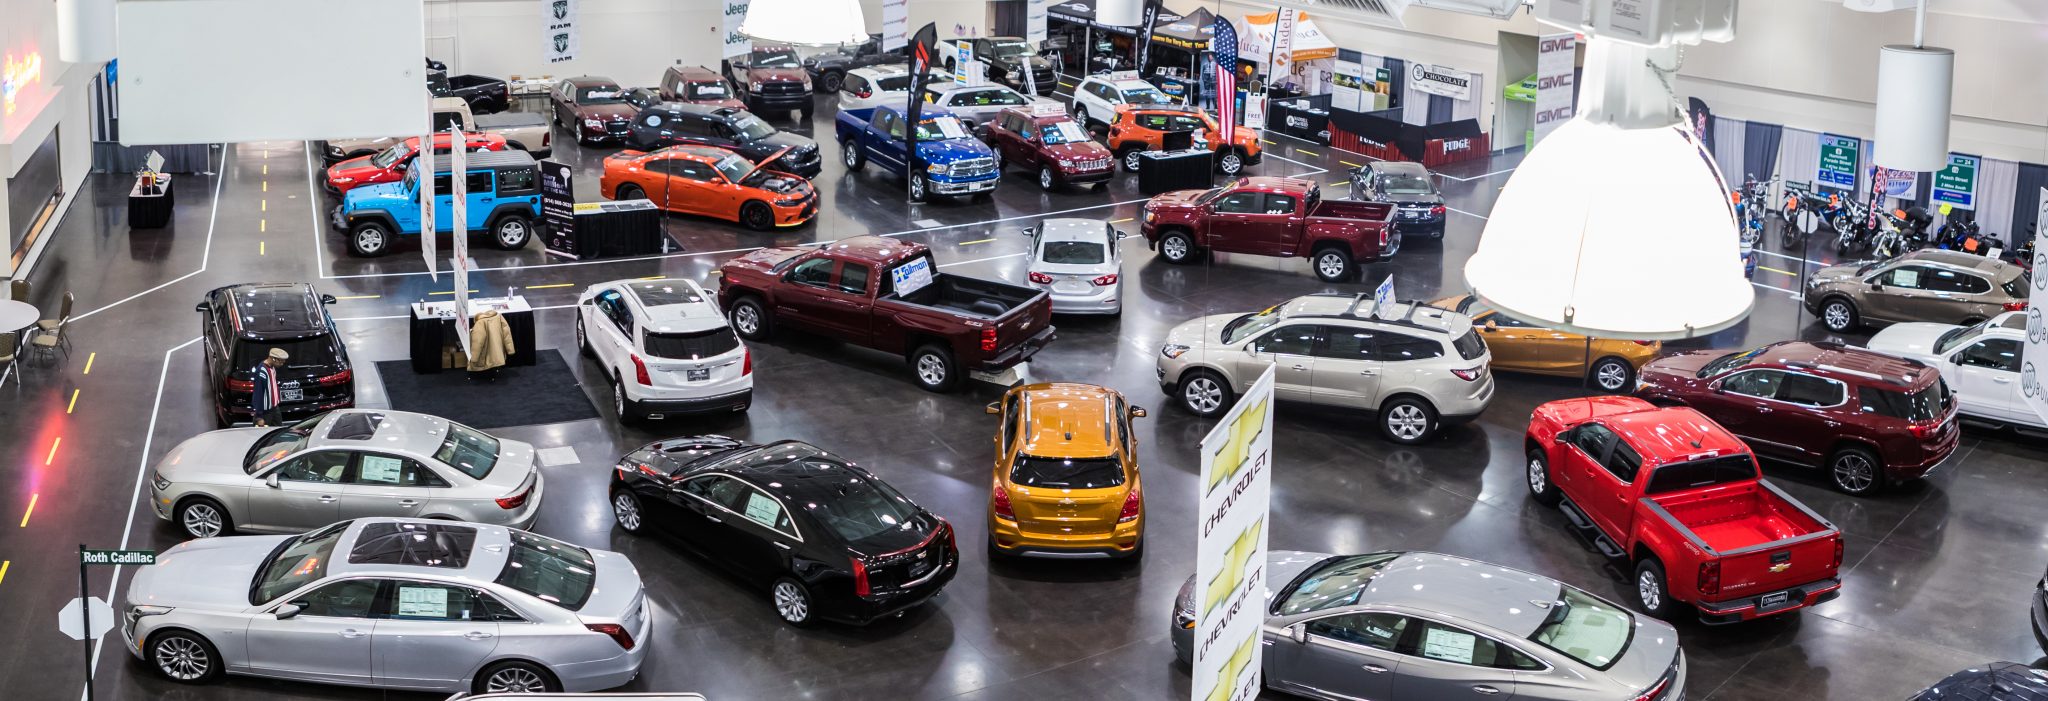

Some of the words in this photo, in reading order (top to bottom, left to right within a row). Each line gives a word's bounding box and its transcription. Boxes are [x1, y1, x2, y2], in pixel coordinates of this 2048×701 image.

[725, 2, 748, 16] Jeep
[1540, 38, 1575, 53] GMC
[1425, 73, 1465, 87] CHOCOLATE
[1538, 74, 1572, 90] GMC
[1536, 107, 1570, 124] GMC
[1443, 138, 1469, 153] FUDGE
[2036, 382, 2048, 406] BUI
[1204, 449, 1267, 539] CHEVROLET
[83, 551, 108, 563] Roth
[110, 551, 153, 563] Cadillac
[1199, 565, 1262, 662] CHEVROLET
